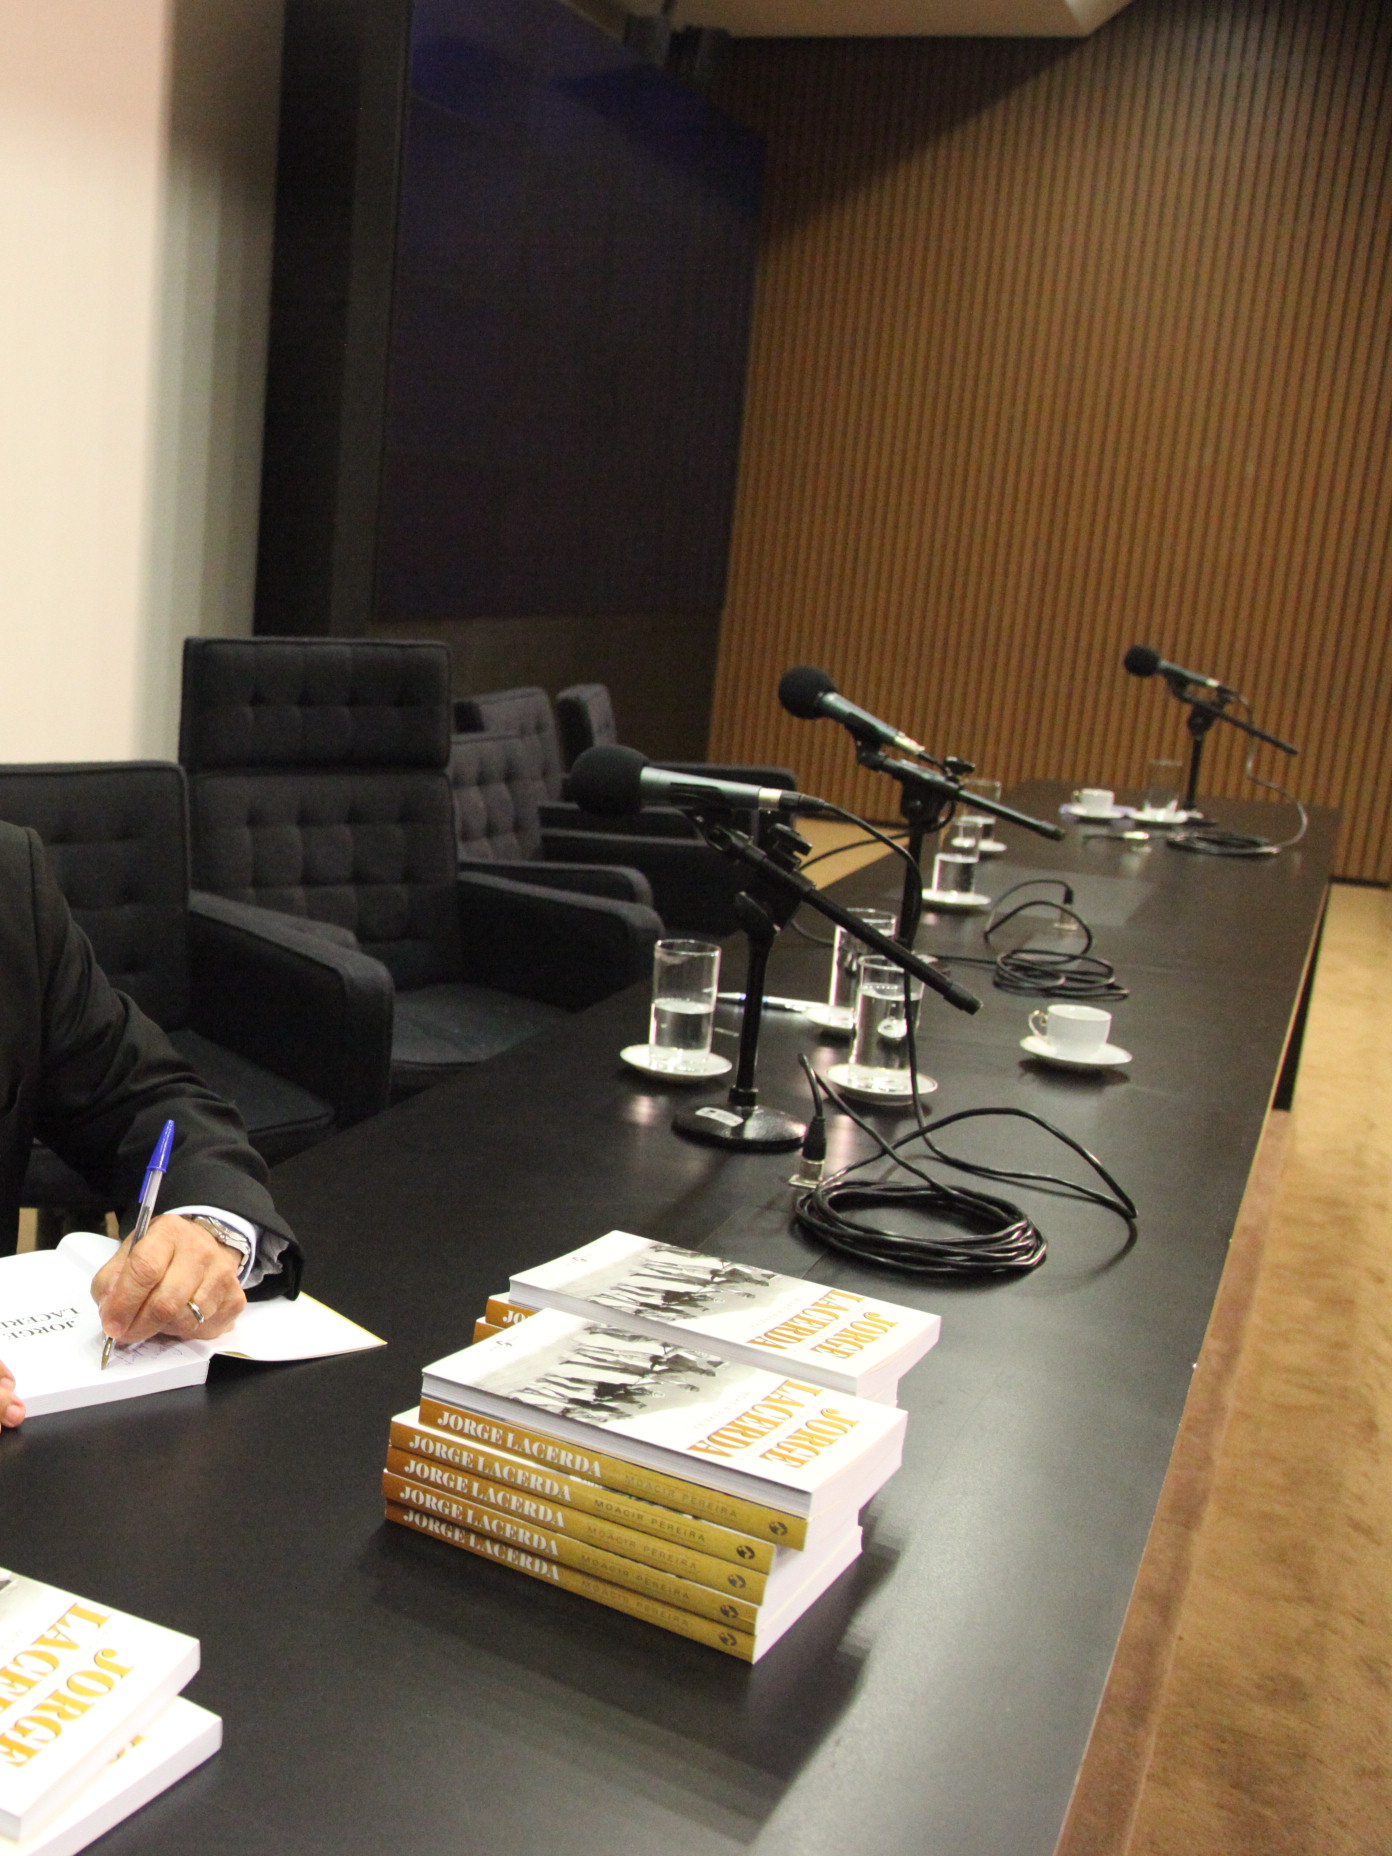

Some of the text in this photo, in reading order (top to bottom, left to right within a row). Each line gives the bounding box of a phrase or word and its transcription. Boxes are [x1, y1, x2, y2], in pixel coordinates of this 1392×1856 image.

[3, 1320, 75, 1340] JORGE
[746, 1289, 865, 1349] LACERDA
[810, 1311, 899, 1359] JORGE
[437, 1411, 503, 1445] JORGE
[508, 1432, 602, 1478] LACERDA
[686, 1379, 824, 1458] LACERDA
[759, 1408, 860, 1469] JORGE
[404, 1459, 698, 1570] JORGE LACERDA MOACIR PEREIRA
[409, 1434, 705, 1543] JORGE LACERDA MOACIR PEREIRA
[399, 1486, 689, 1600] JORGE LACERDA MOACIR PEREIRA
[403, 1510, 465, 1544] JORGE
[469, 1533, 560, 1581] LACERDA
